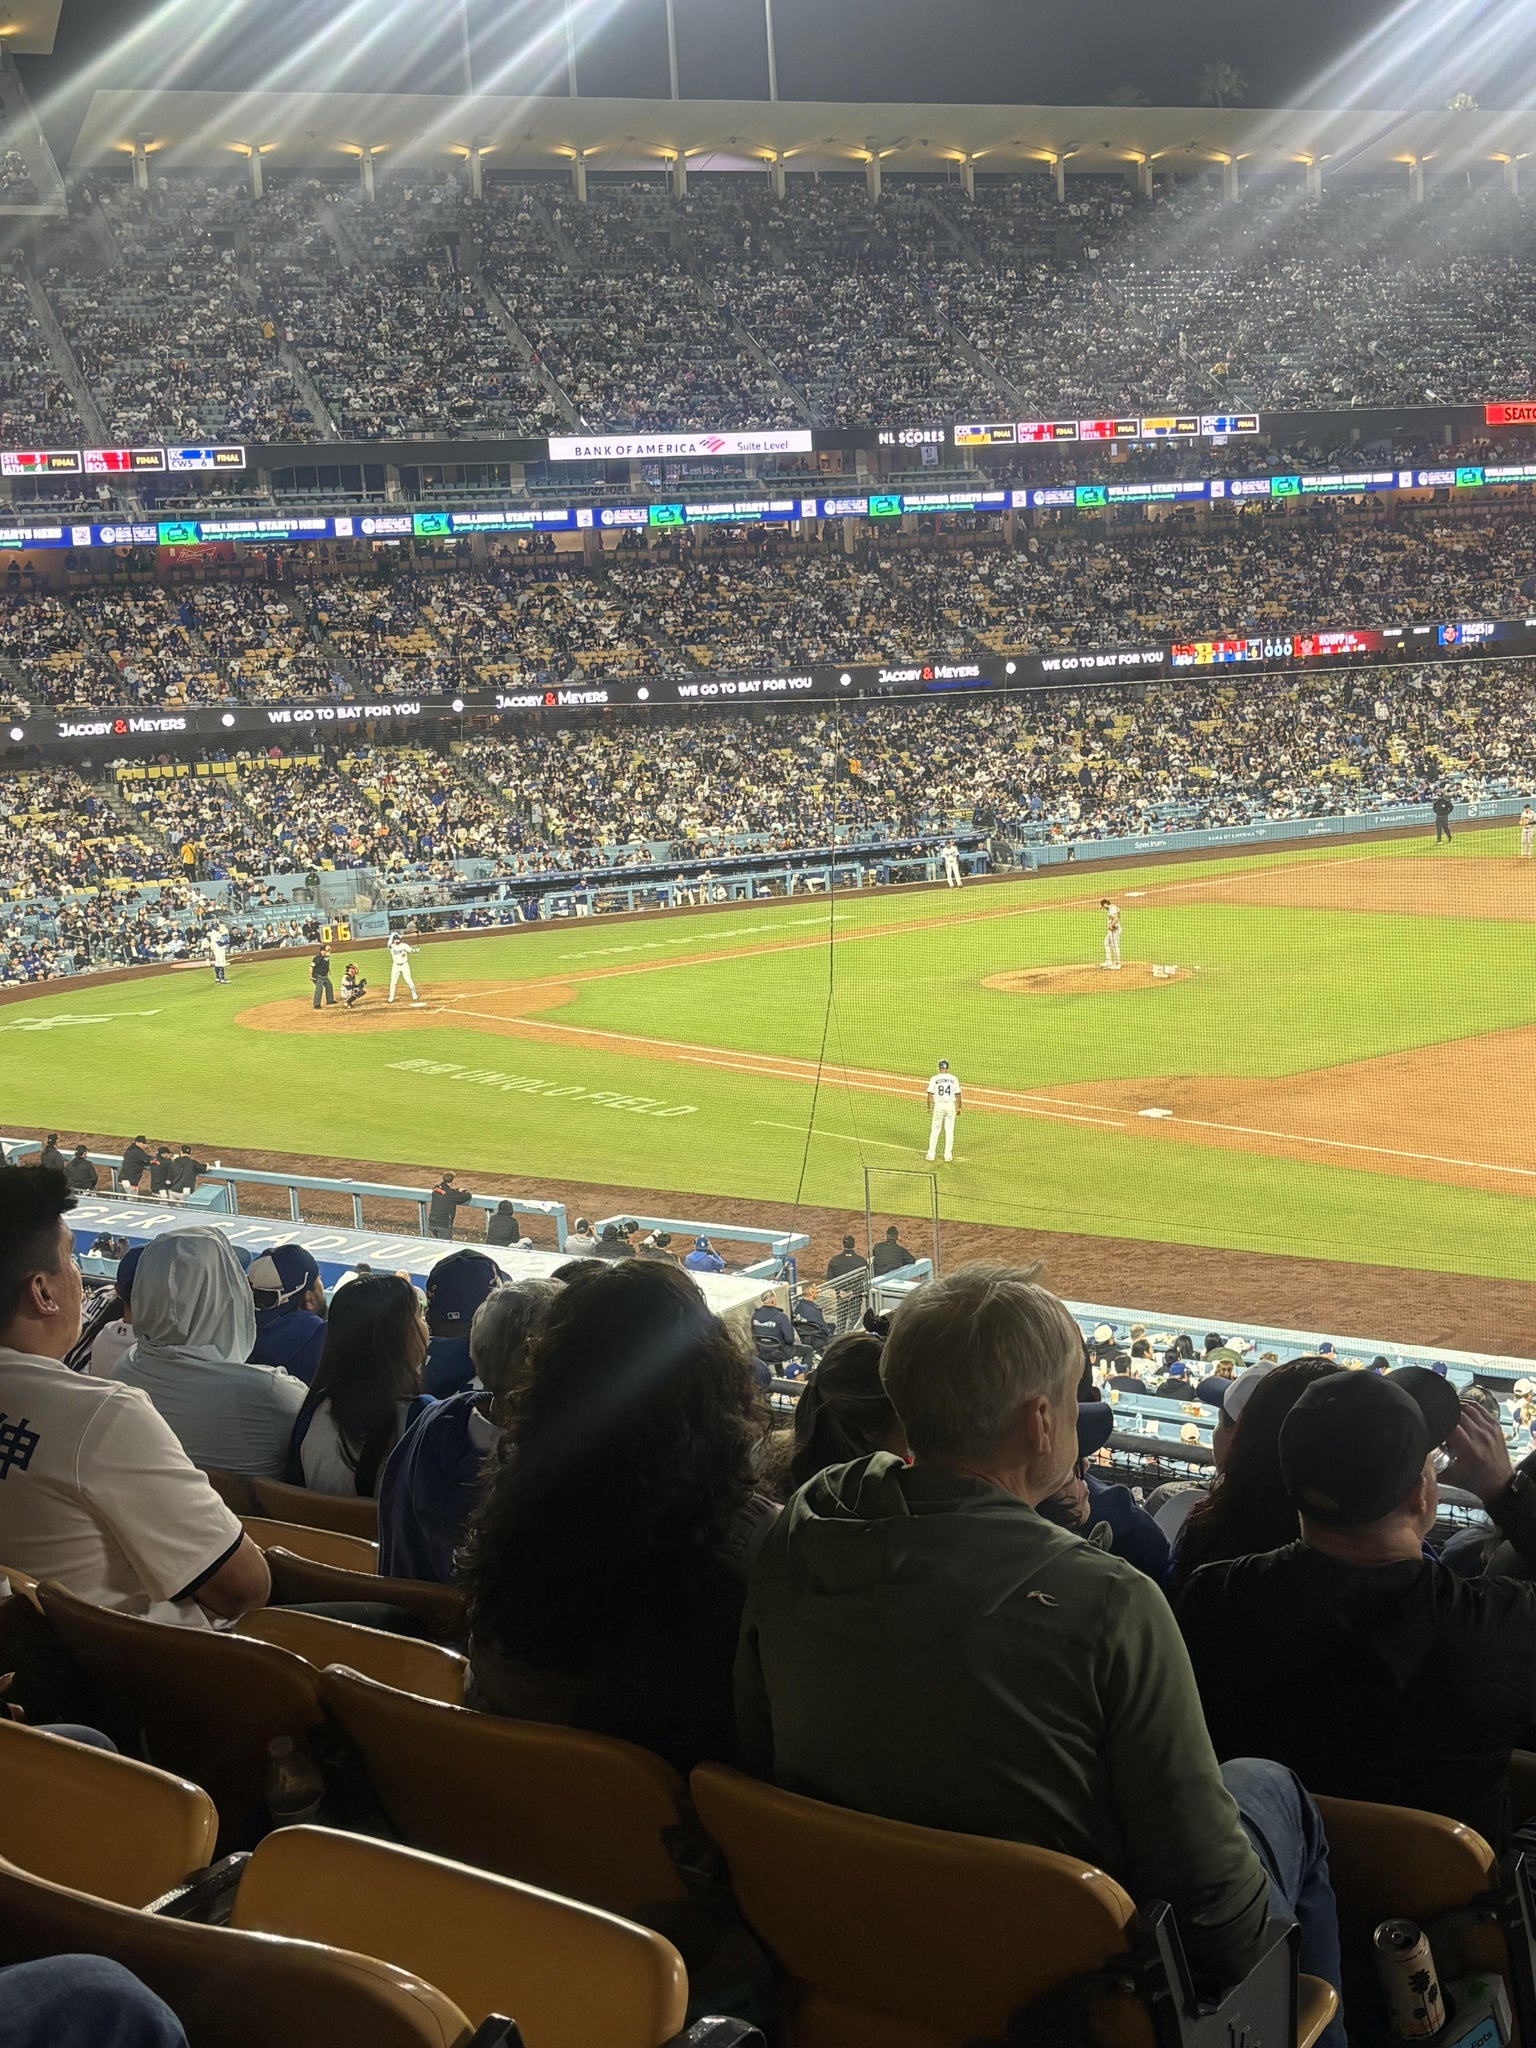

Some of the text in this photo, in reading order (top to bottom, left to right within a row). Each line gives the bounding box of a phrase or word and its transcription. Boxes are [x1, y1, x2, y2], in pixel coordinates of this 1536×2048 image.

[878, 430, 945, 444] NL SCORES
[993, 430, 1011, 438] FINAL
[575, 443, 696, 456] BANK OF AMERICA
[737, 441, 788, 451] Suite Level
[52, 459, 75, 467] FINAL
[136, 456, 159, 464] FINAL
[172, 460, 193, 468] CWS
[216, 454, 239, 462] FINAL
[1251, 646, 1258, 658] 6
[1264, 644, 1292, 658] 0 0 0
[1042, 652, 1164, 671] WE GO TO BAT FOR YOU
[879, 665, 979, 683] JACOBY & MEYERS
[678, 677, 812, 697] WE GO TO BAT FOR YOU
[496, 690, 608, 709] JACOBY & MEYERS
[268, 702, 421, 723] WE GO TO BAT FOR YOU
[58, 718, 186, 738] JACOBY & MEYERS
[451, 1070, 699, 1117] UNIQLO FIELD
[938, 1084, 951, 1096] 84
